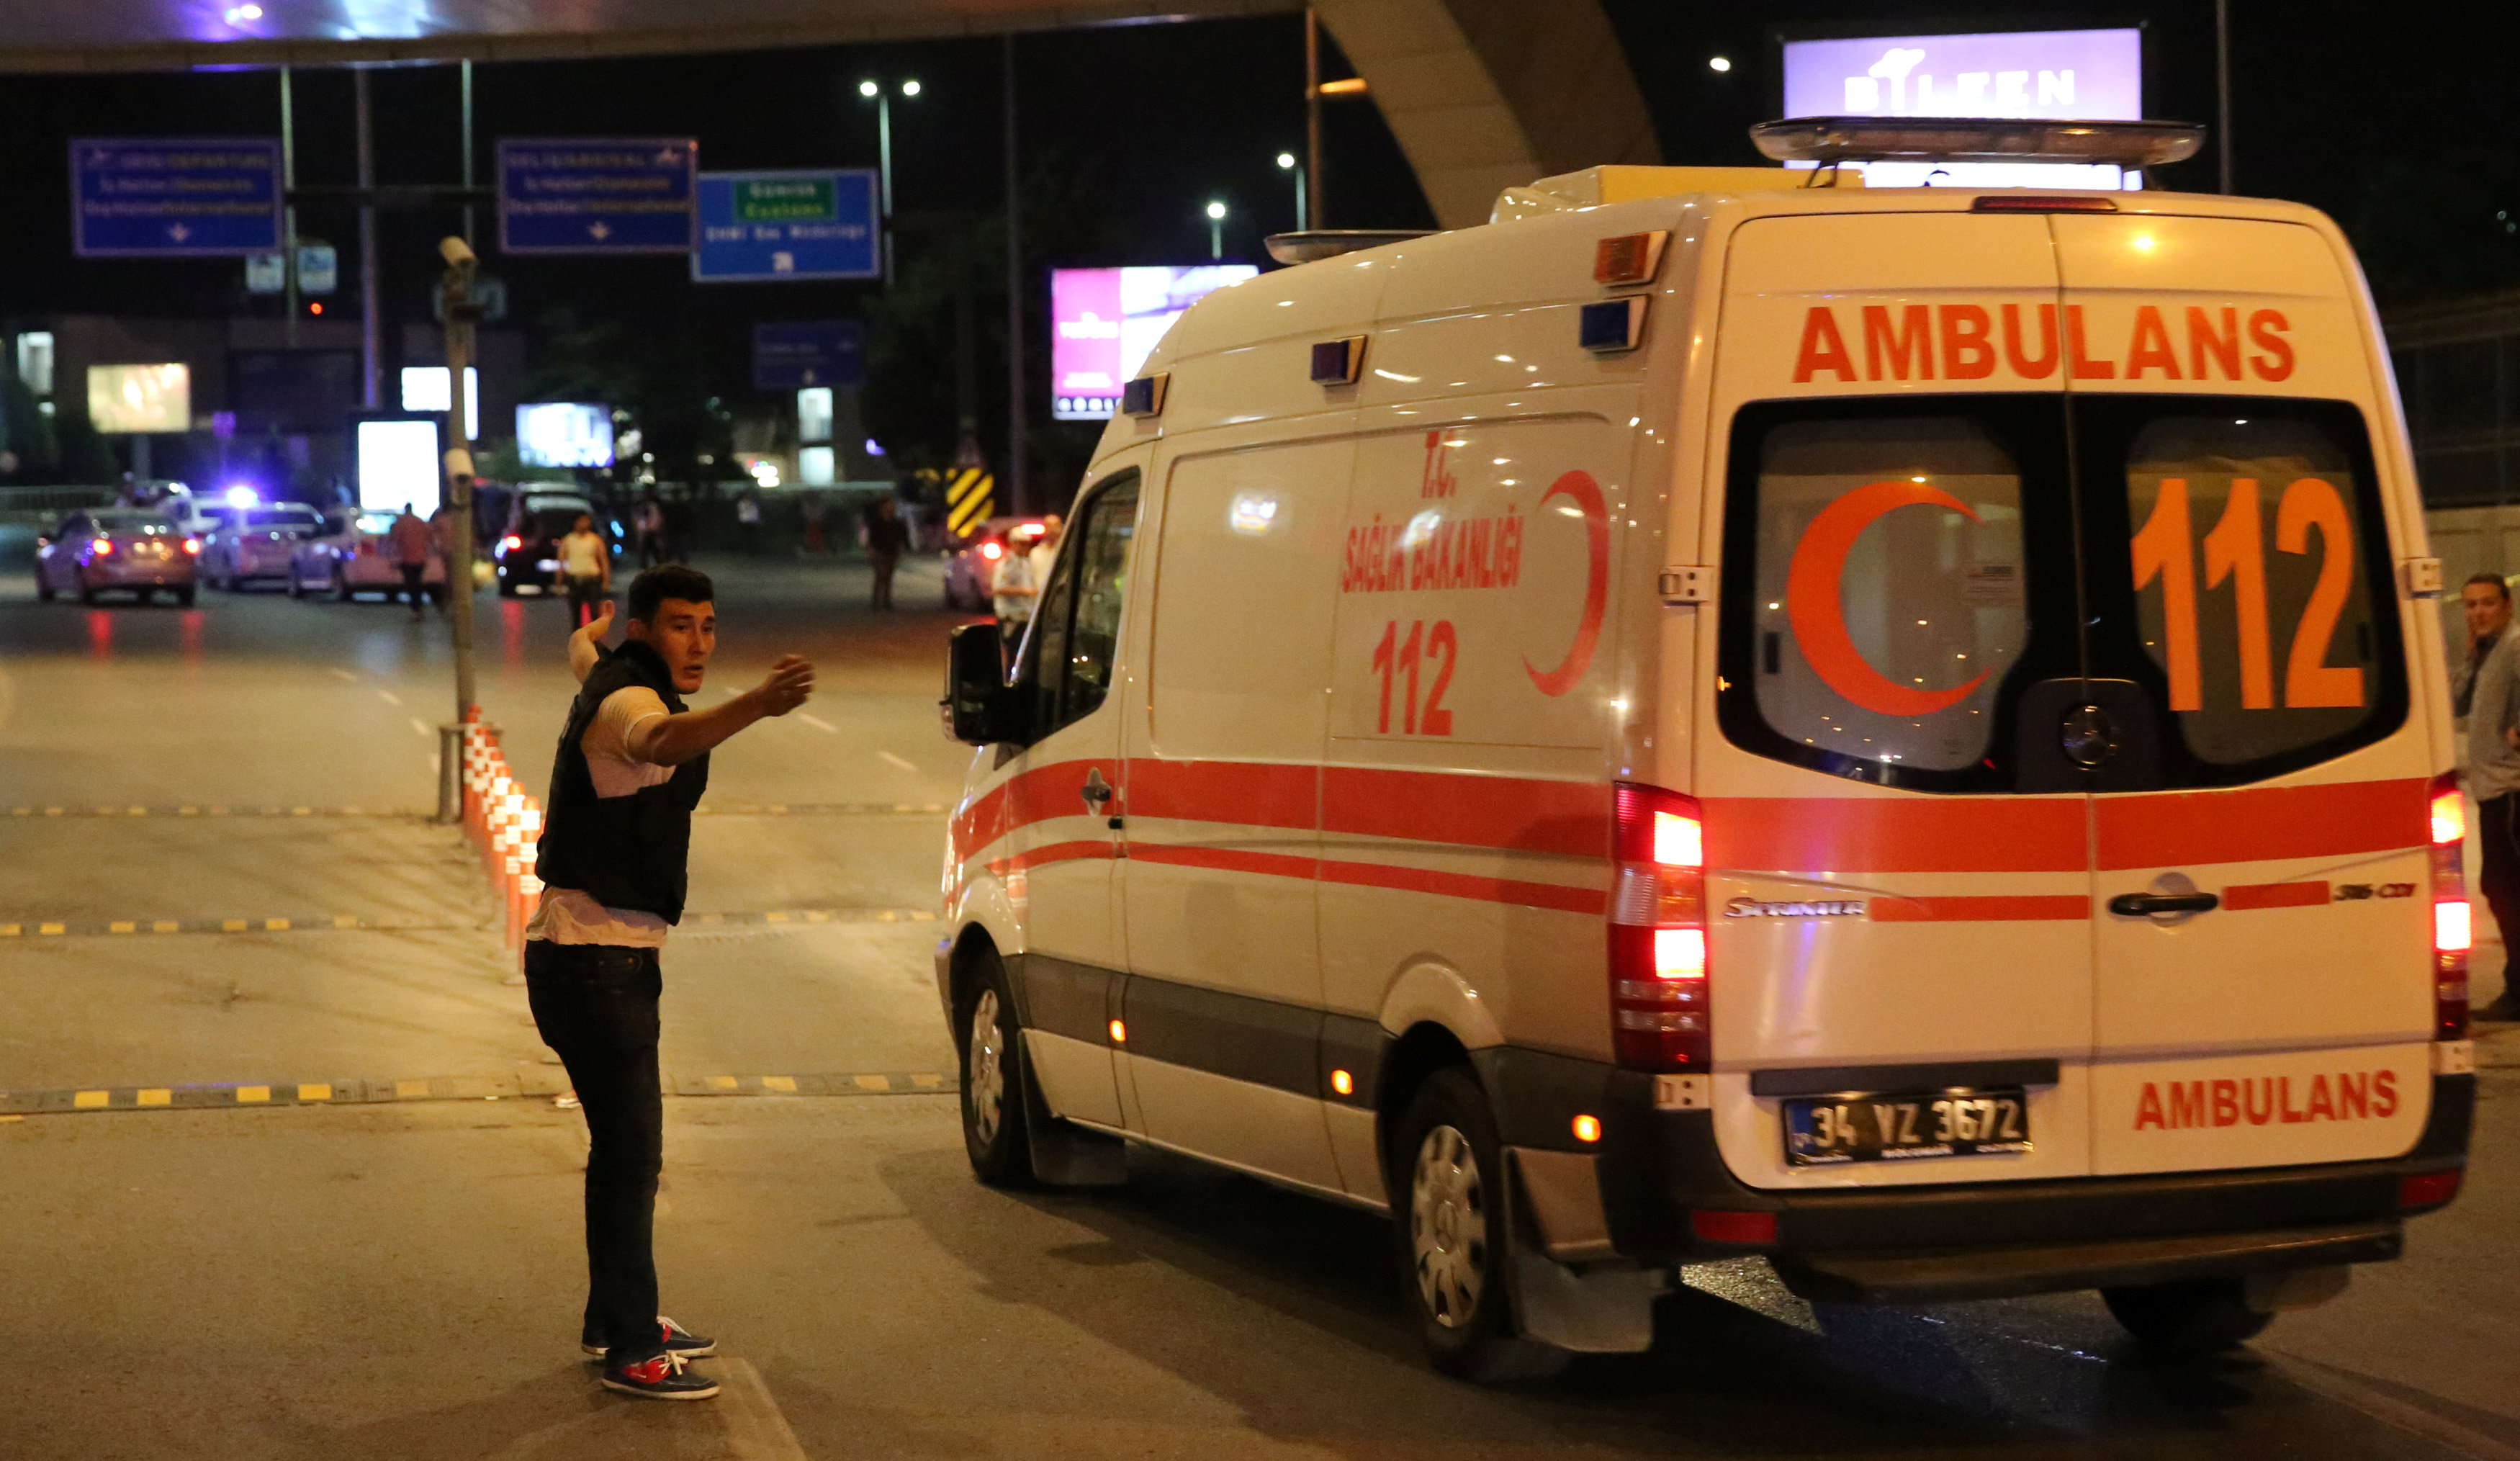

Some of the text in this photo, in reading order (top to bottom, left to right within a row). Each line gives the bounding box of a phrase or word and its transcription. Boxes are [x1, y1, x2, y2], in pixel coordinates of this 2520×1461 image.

[1791, 302, 2296, 383] AMBULANS
[2130, 477, 2366, 711] 112
[1372, 620, 1458, 735] 112
[1810, 1105, 1858, 1147] 34
[1931, 1100, 2024, 1142] 3672
[2133, 1069, 2398, 1130] AMBULANS
